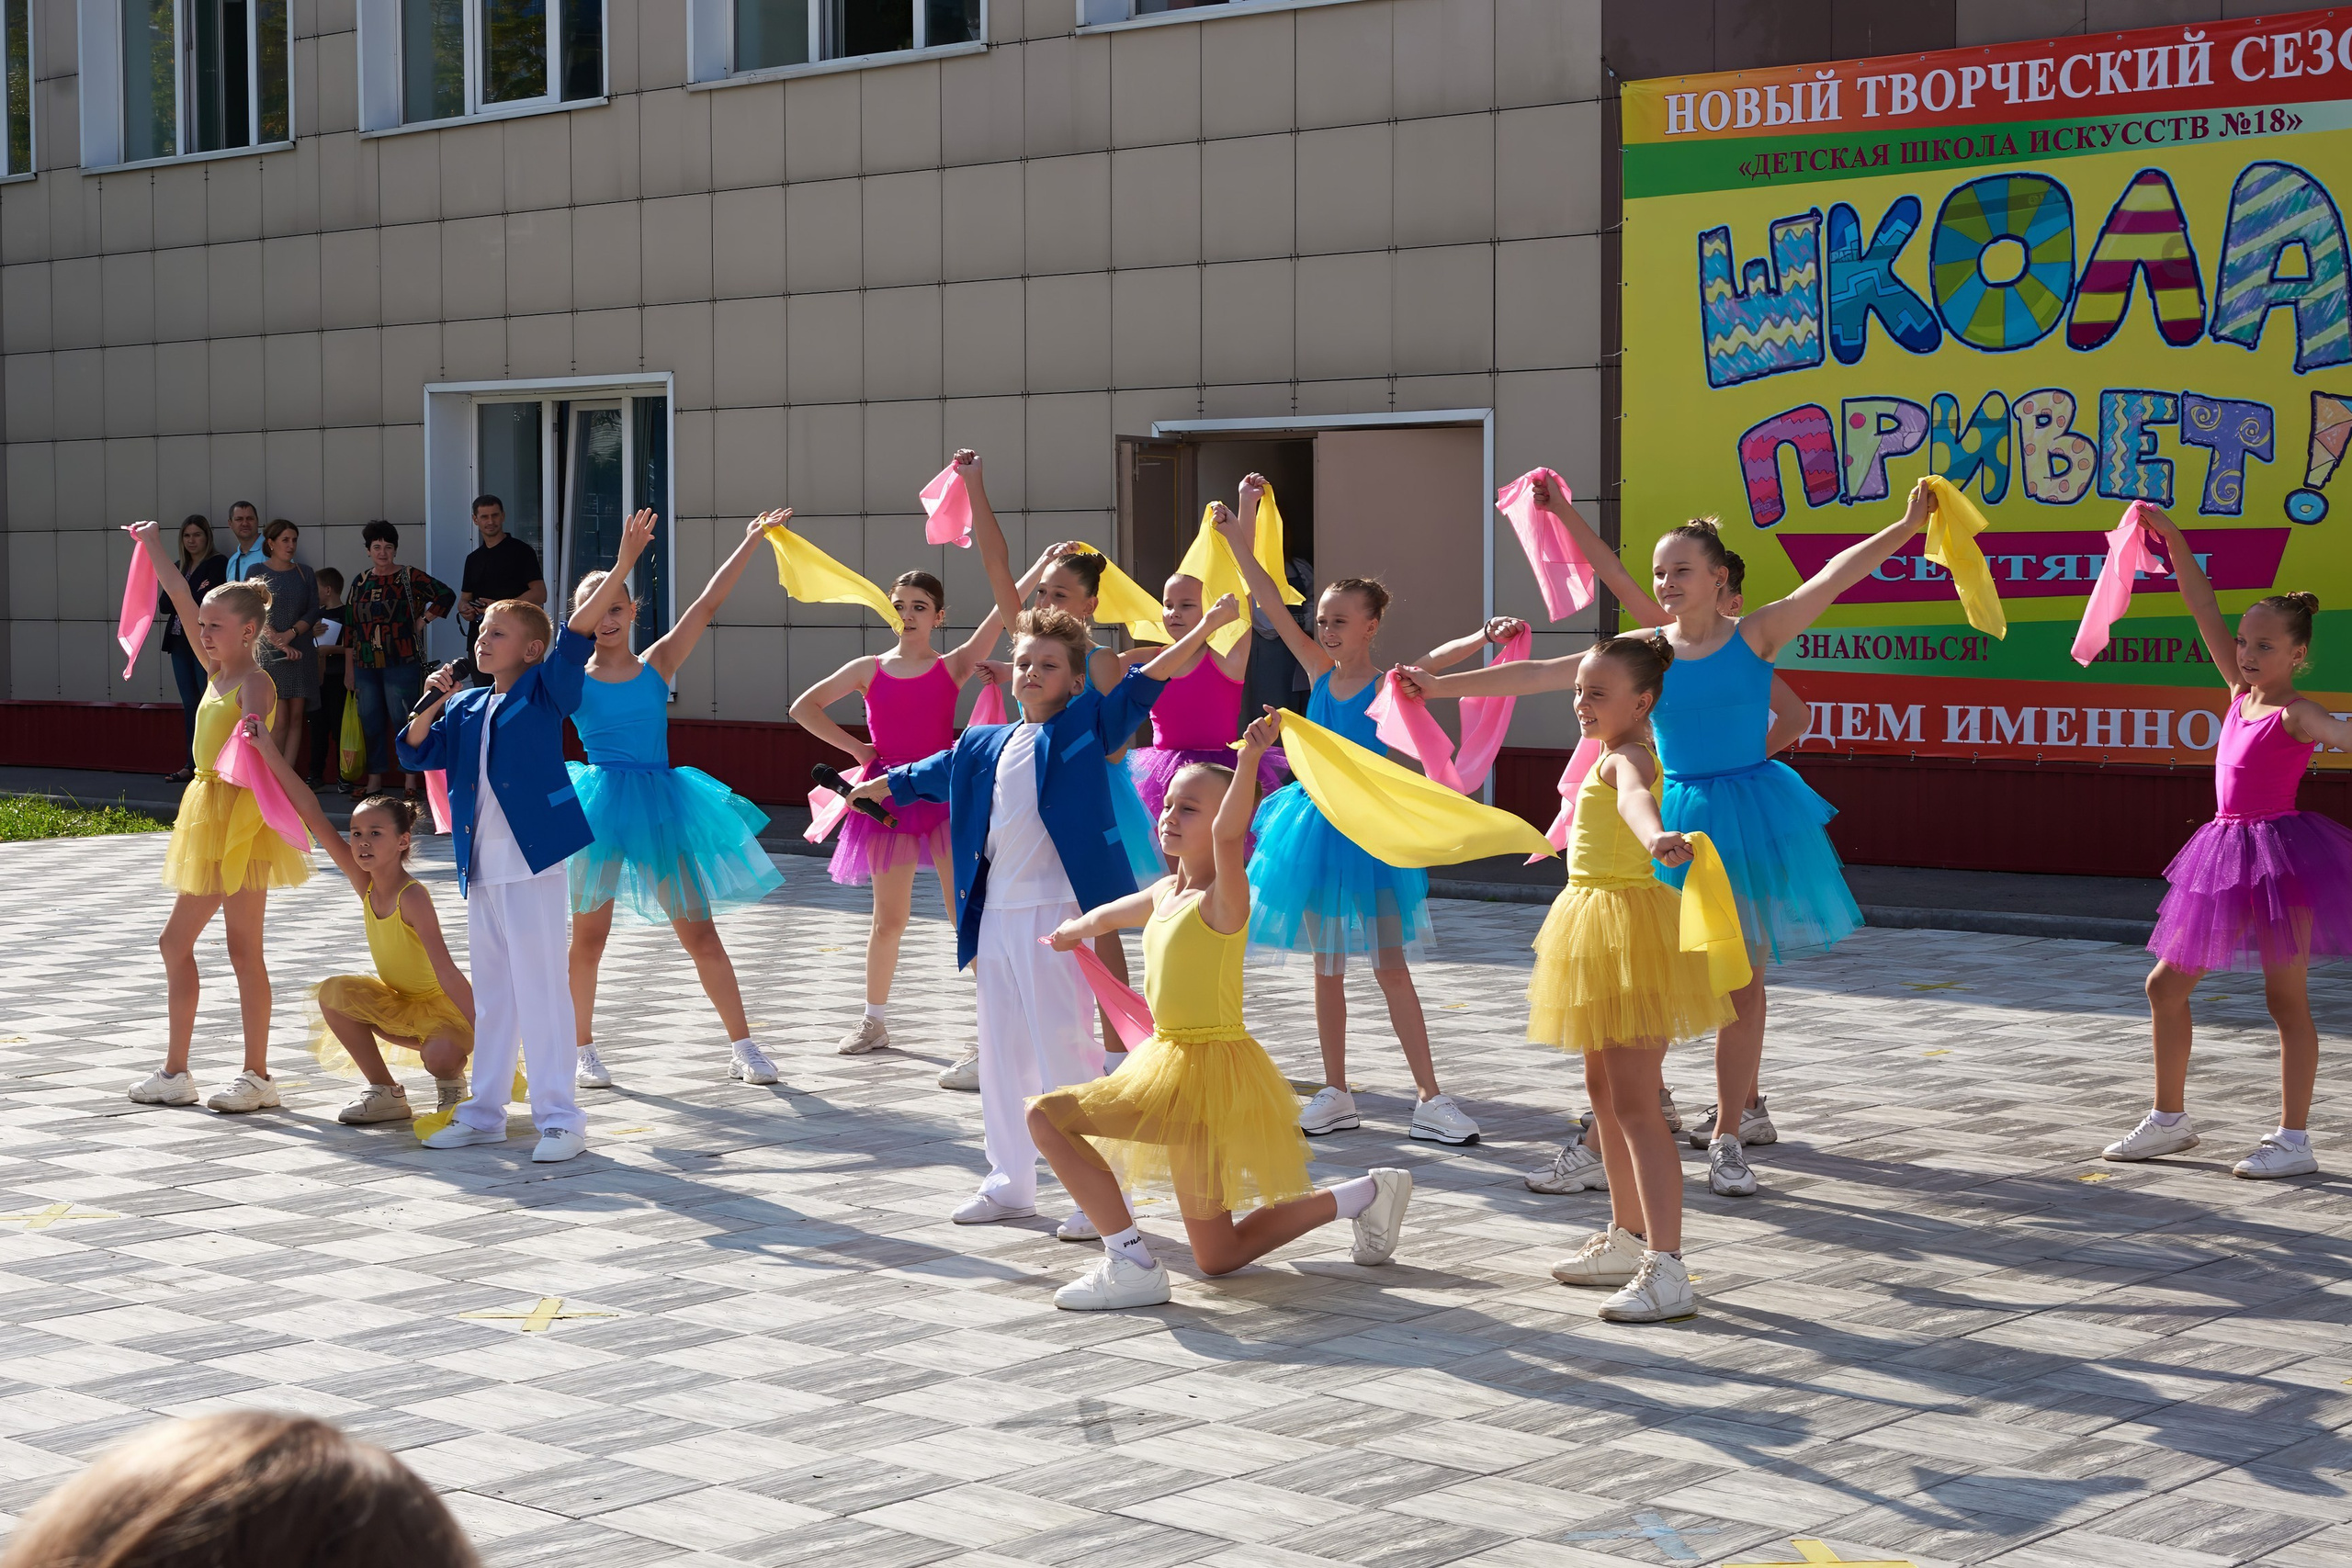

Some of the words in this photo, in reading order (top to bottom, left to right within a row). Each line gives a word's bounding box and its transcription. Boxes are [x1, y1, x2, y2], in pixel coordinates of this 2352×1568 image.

[1664, 71, 1842, 136] НОВЫЙ
[1857, 30, 2215, 118] ТВОРЧЕСКИЙ
[1738, 143, 1890, 182] «ДЕТСКАЯ
[1899, 133, 2018, 166] ШКОЛА
[2029, 115, 2210, 152] ИСКУССТВ
[2219, 107, 2303, 138] №18»
[1698, 161, 2352, 388] ШКОЛА
[1795, 633, 1989, 661] ЗНАКОМЬСЯ!
[2070, 637, 2215, 663] ЫБИРА
[1941, 705, 2222, 751] ИМЕННО
